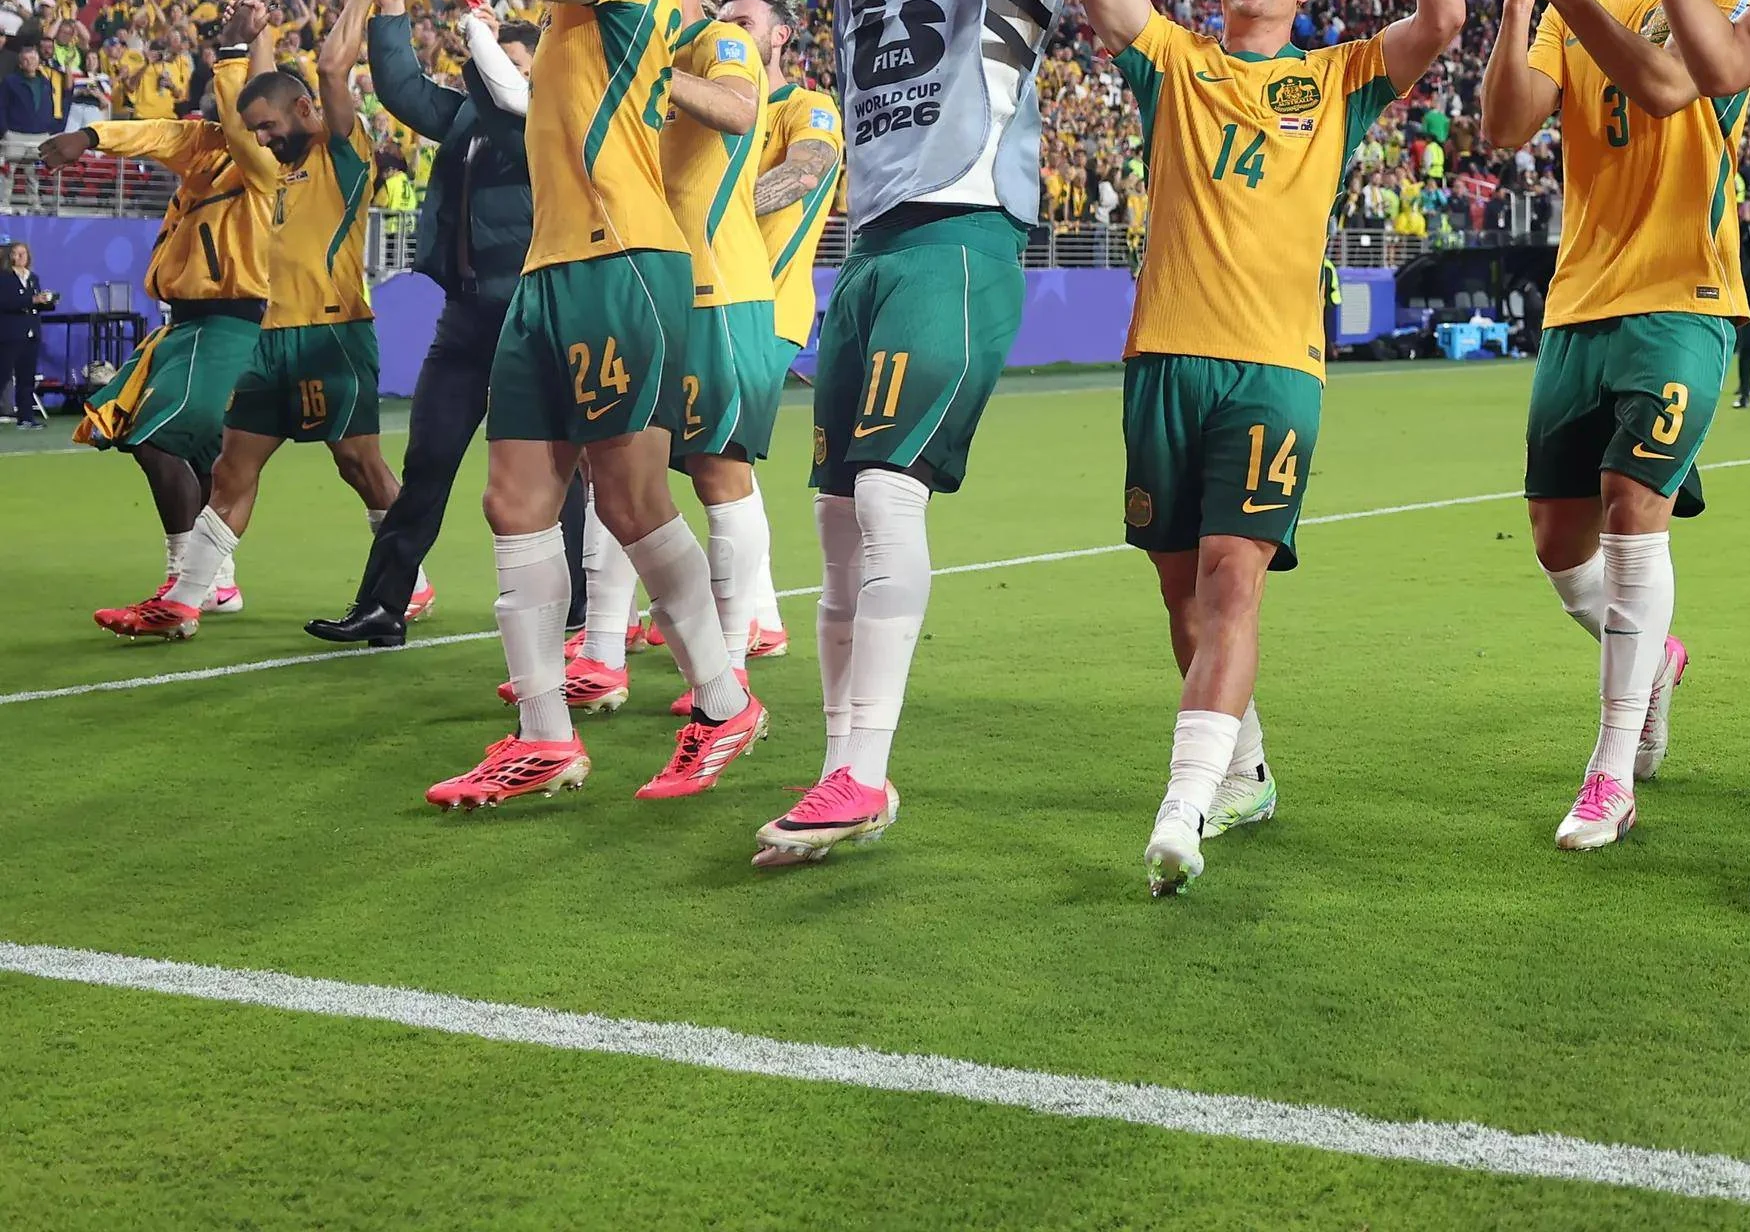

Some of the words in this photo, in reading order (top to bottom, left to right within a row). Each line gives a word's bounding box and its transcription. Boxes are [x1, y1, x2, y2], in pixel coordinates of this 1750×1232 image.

[872, 47, 915, 73] FIFA
[854, 90, 903, 118] WORLD
[907, 82, 942, 101] CUP
[854, 102, 941, 146] 2026
[1604, 85, 1630, 147] 3
[1212, 123, 1265, 189] 14
[298, 379, 326, 419] 16
[568, 338, 631, 403] 24
[682, 375, 700, 426] 2
[863, 350, 909, 418] 11
[1651, 381, 1689, 446] 3
[1245, 423, 1298, 497] 14
